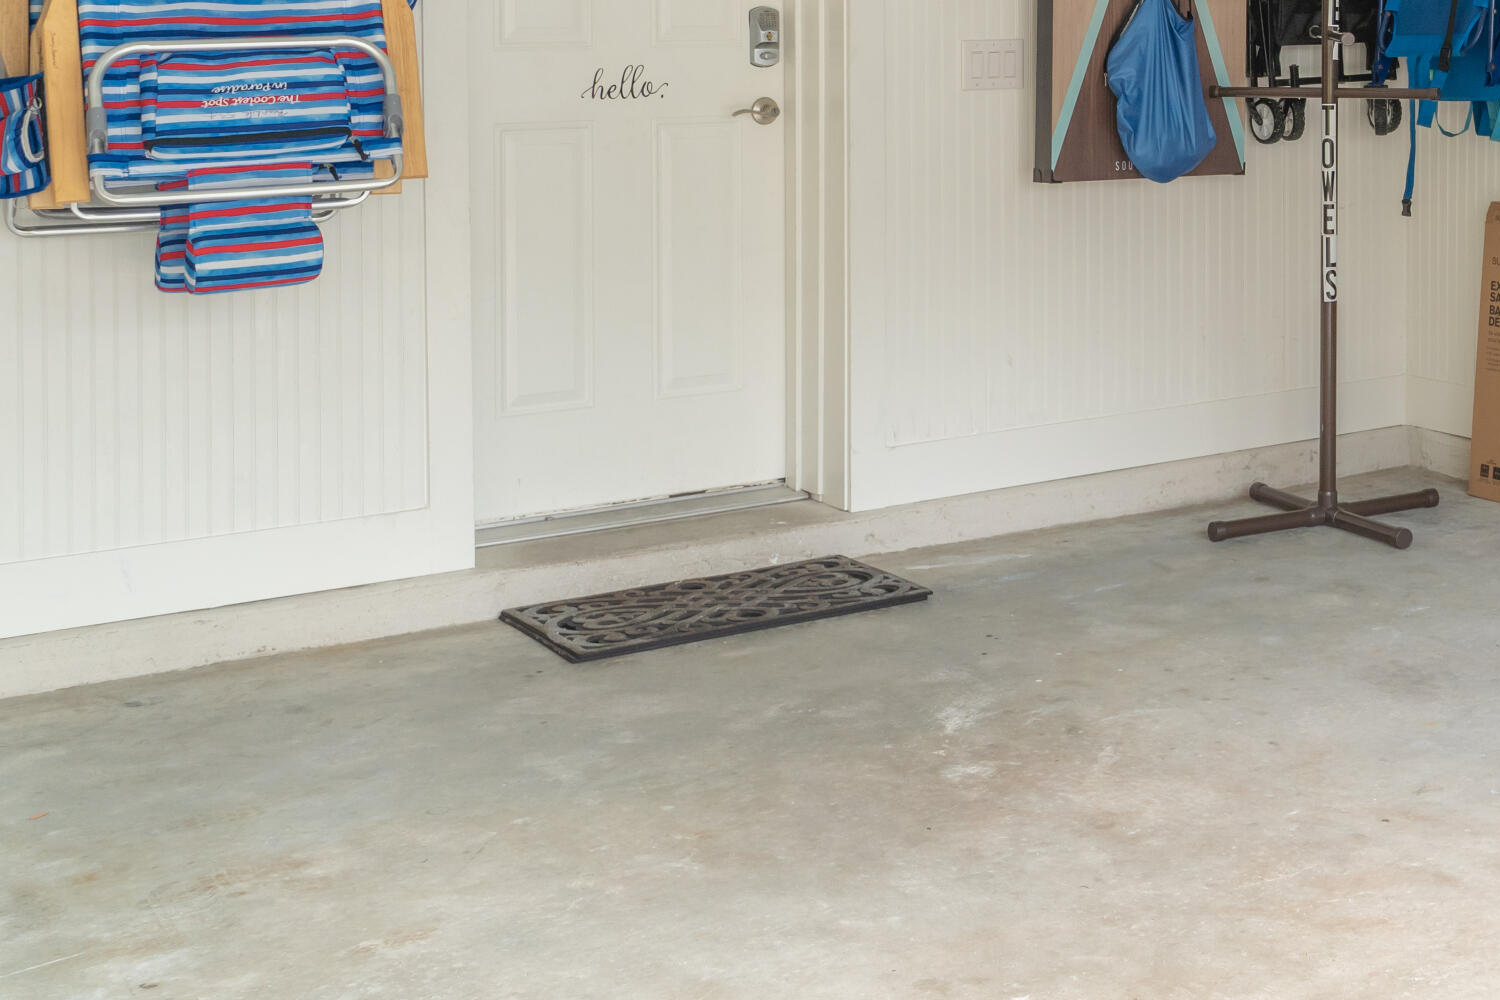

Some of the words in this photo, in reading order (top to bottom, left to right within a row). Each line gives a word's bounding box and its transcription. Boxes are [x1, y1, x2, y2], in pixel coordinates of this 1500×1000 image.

[211, 82, 271, 94] Paradise
[201, 96, 230, 108] Spot
[231, 96, 276, 106] Coolest
[277, 94, 301, 104] The
[1115, 160, 1133, 171] SOU
[1321, 105, 1337, 300] TOWELS
